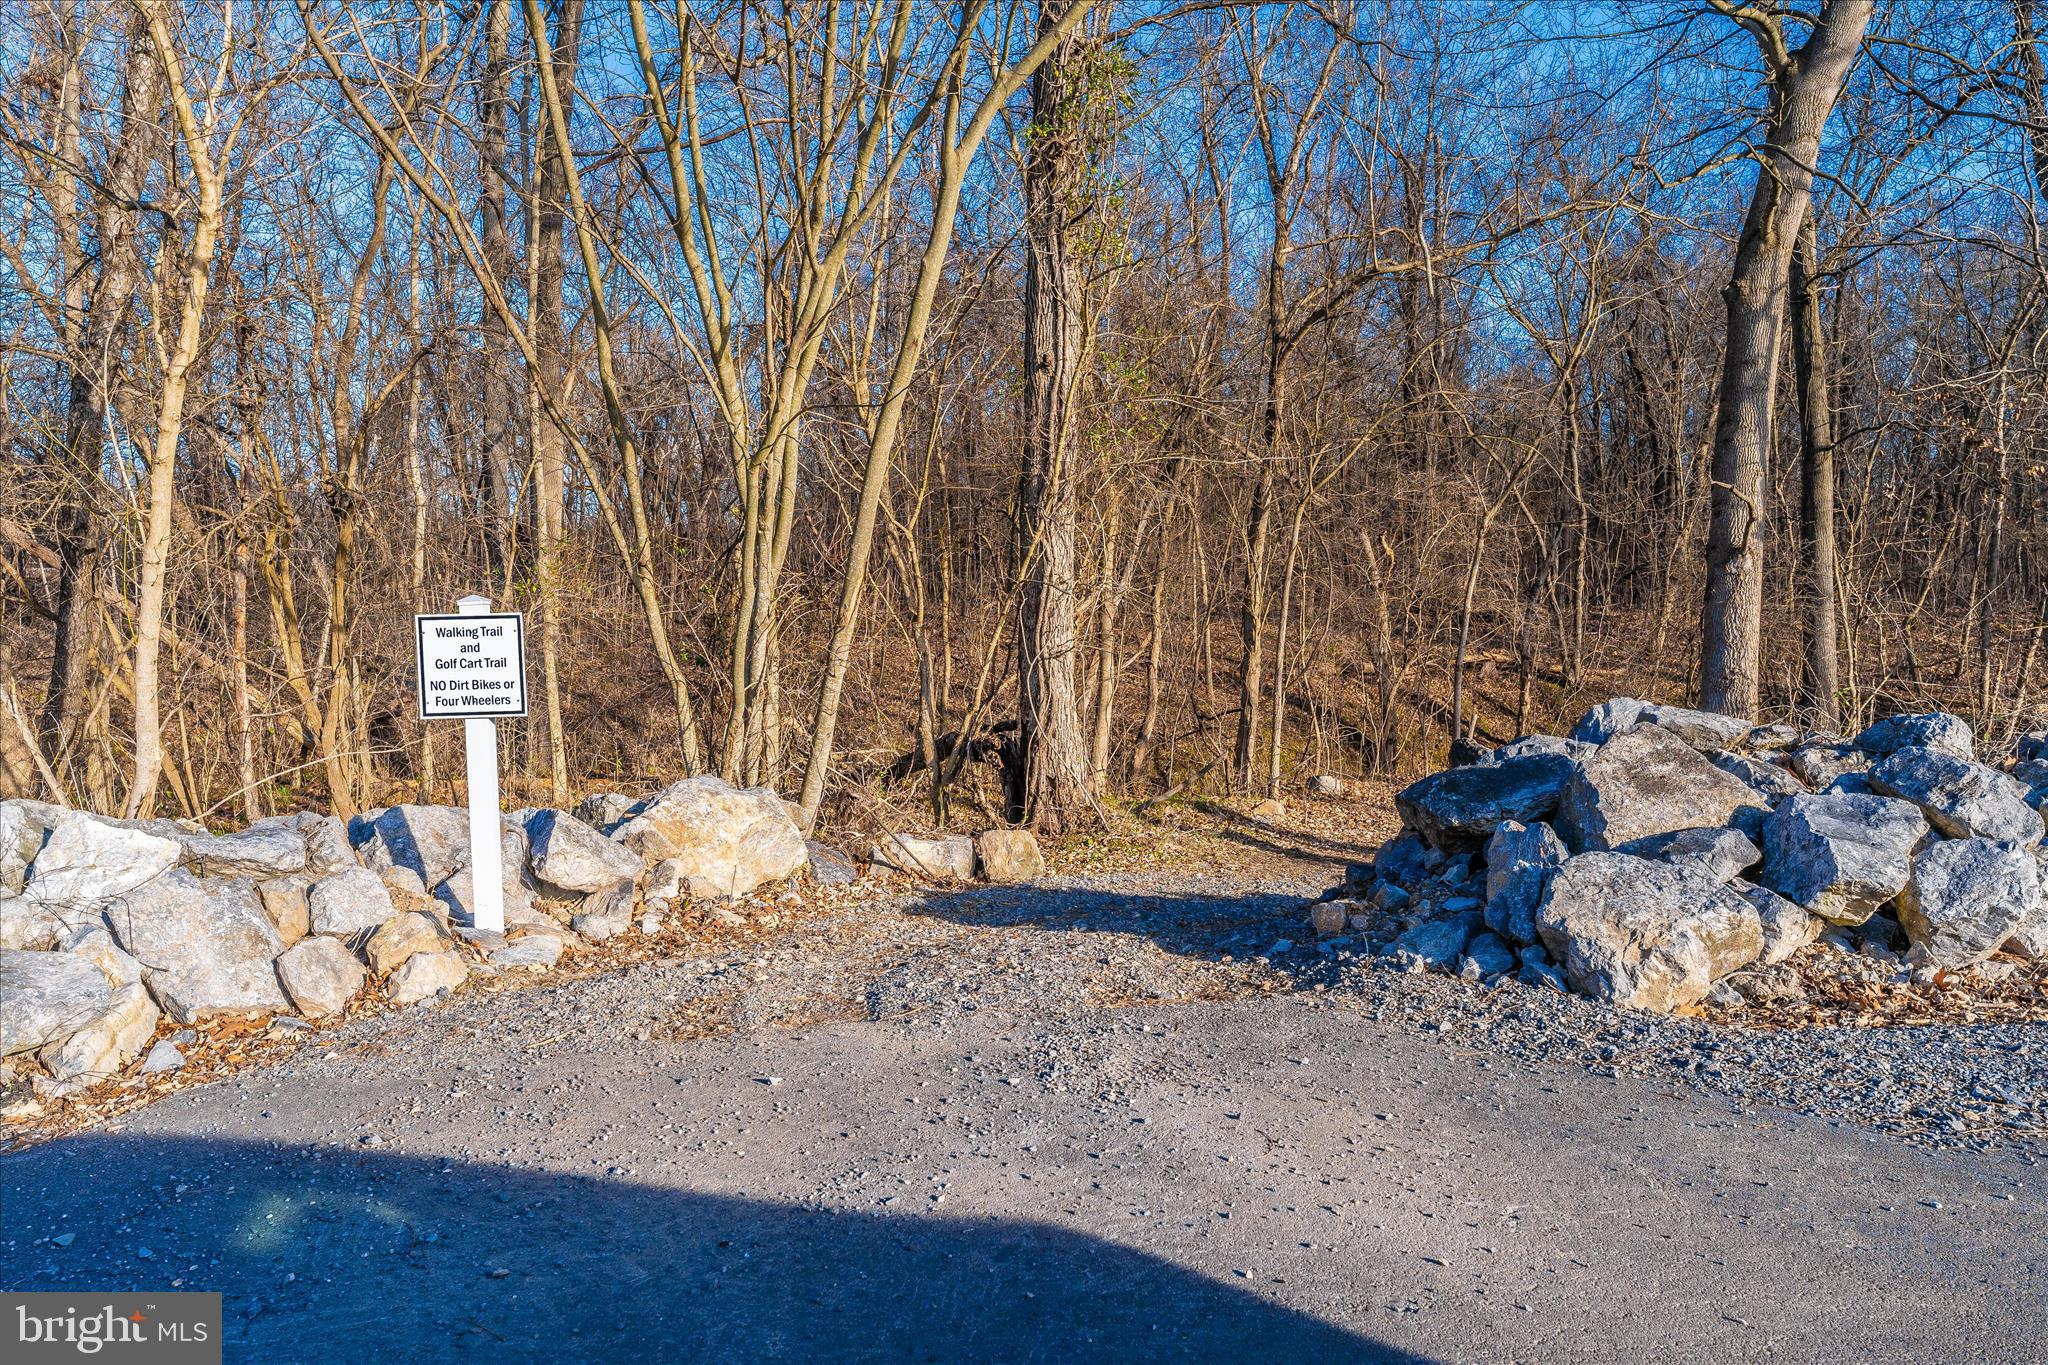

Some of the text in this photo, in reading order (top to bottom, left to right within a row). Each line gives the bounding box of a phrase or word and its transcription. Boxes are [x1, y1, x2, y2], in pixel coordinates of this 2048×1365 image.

[435, 626, 503, 640] Walking Trail
[460, 642, 480, 653] and
[435, 657, 507, 669] Golf Cart Trail
[430, 679, 515, 691] NO Dirt Bikes or
[435, 695, 511, 707] Four Wheelers
